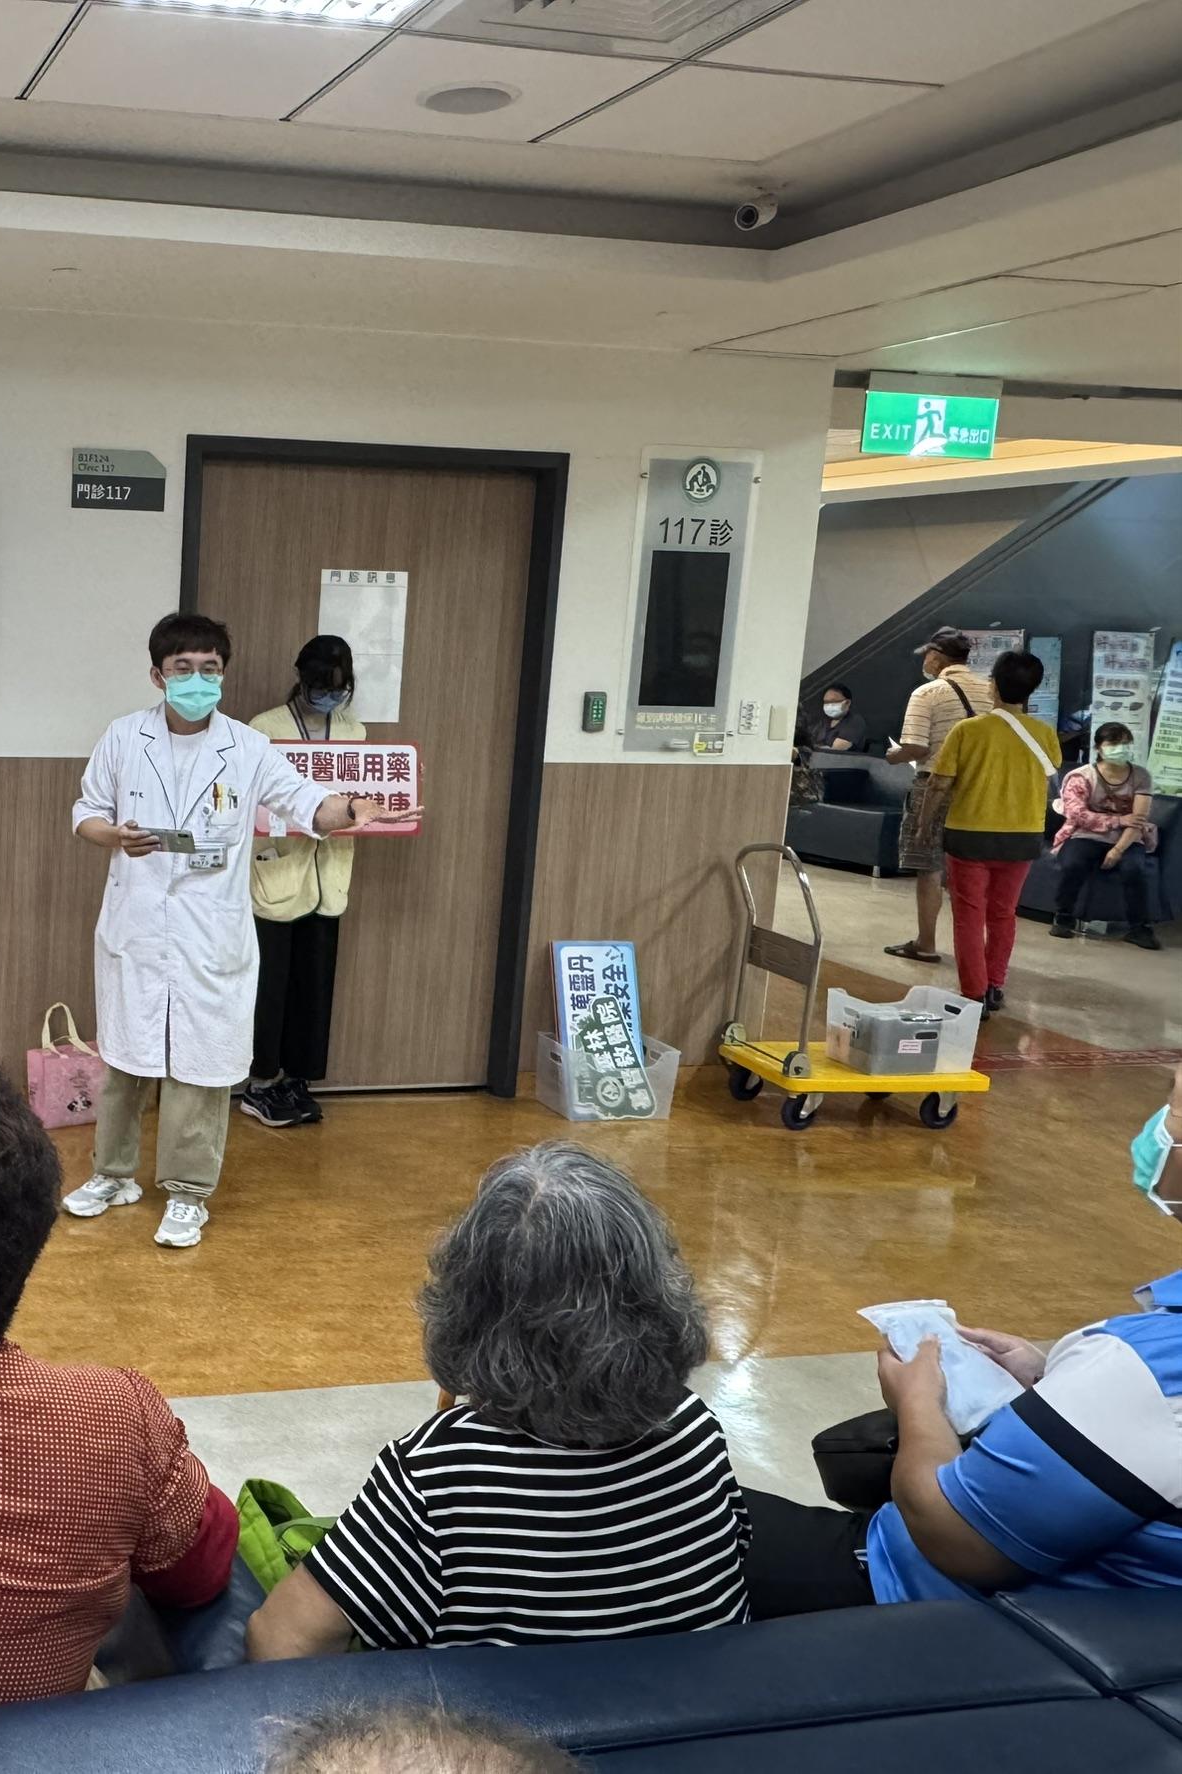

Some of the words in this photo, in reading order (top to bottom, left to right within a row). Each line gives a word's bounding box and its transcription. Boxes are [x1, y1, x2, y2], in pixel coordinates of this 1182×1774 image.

[870, 423, 911, 440] EXIT
[101, 464, 115, 472] 117
[77, 483, 131, 500] 門診117
[659, 517, 734, 547] 117診
[568, 955, 596, 1022] 萬靈丹
